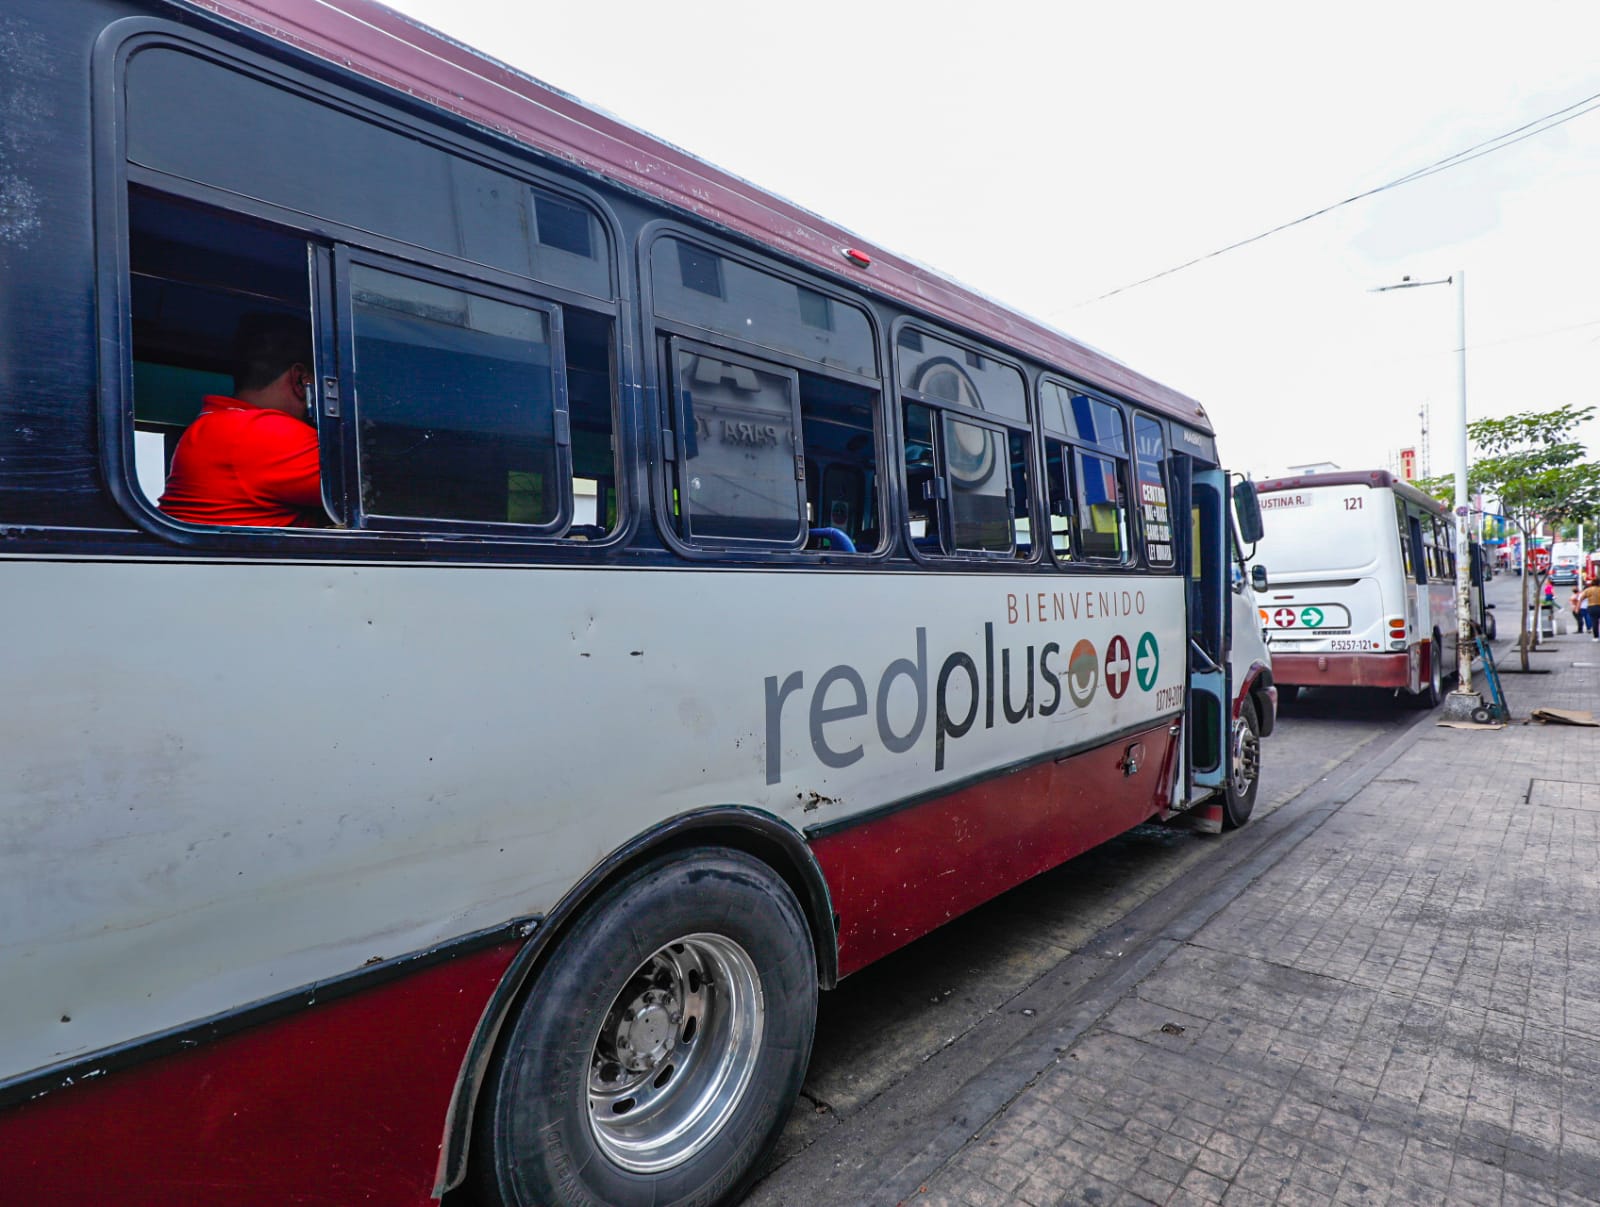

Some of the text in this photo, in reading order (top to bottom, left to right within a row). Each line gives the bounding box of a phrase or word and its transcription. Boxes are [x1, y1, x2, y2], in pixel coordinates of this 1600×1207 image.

[1258, 497, 1294, 509] USTINA
[1344, 497, 1363, 510] 121
[1007, 590, 1146, 624] BIENVENIDO
